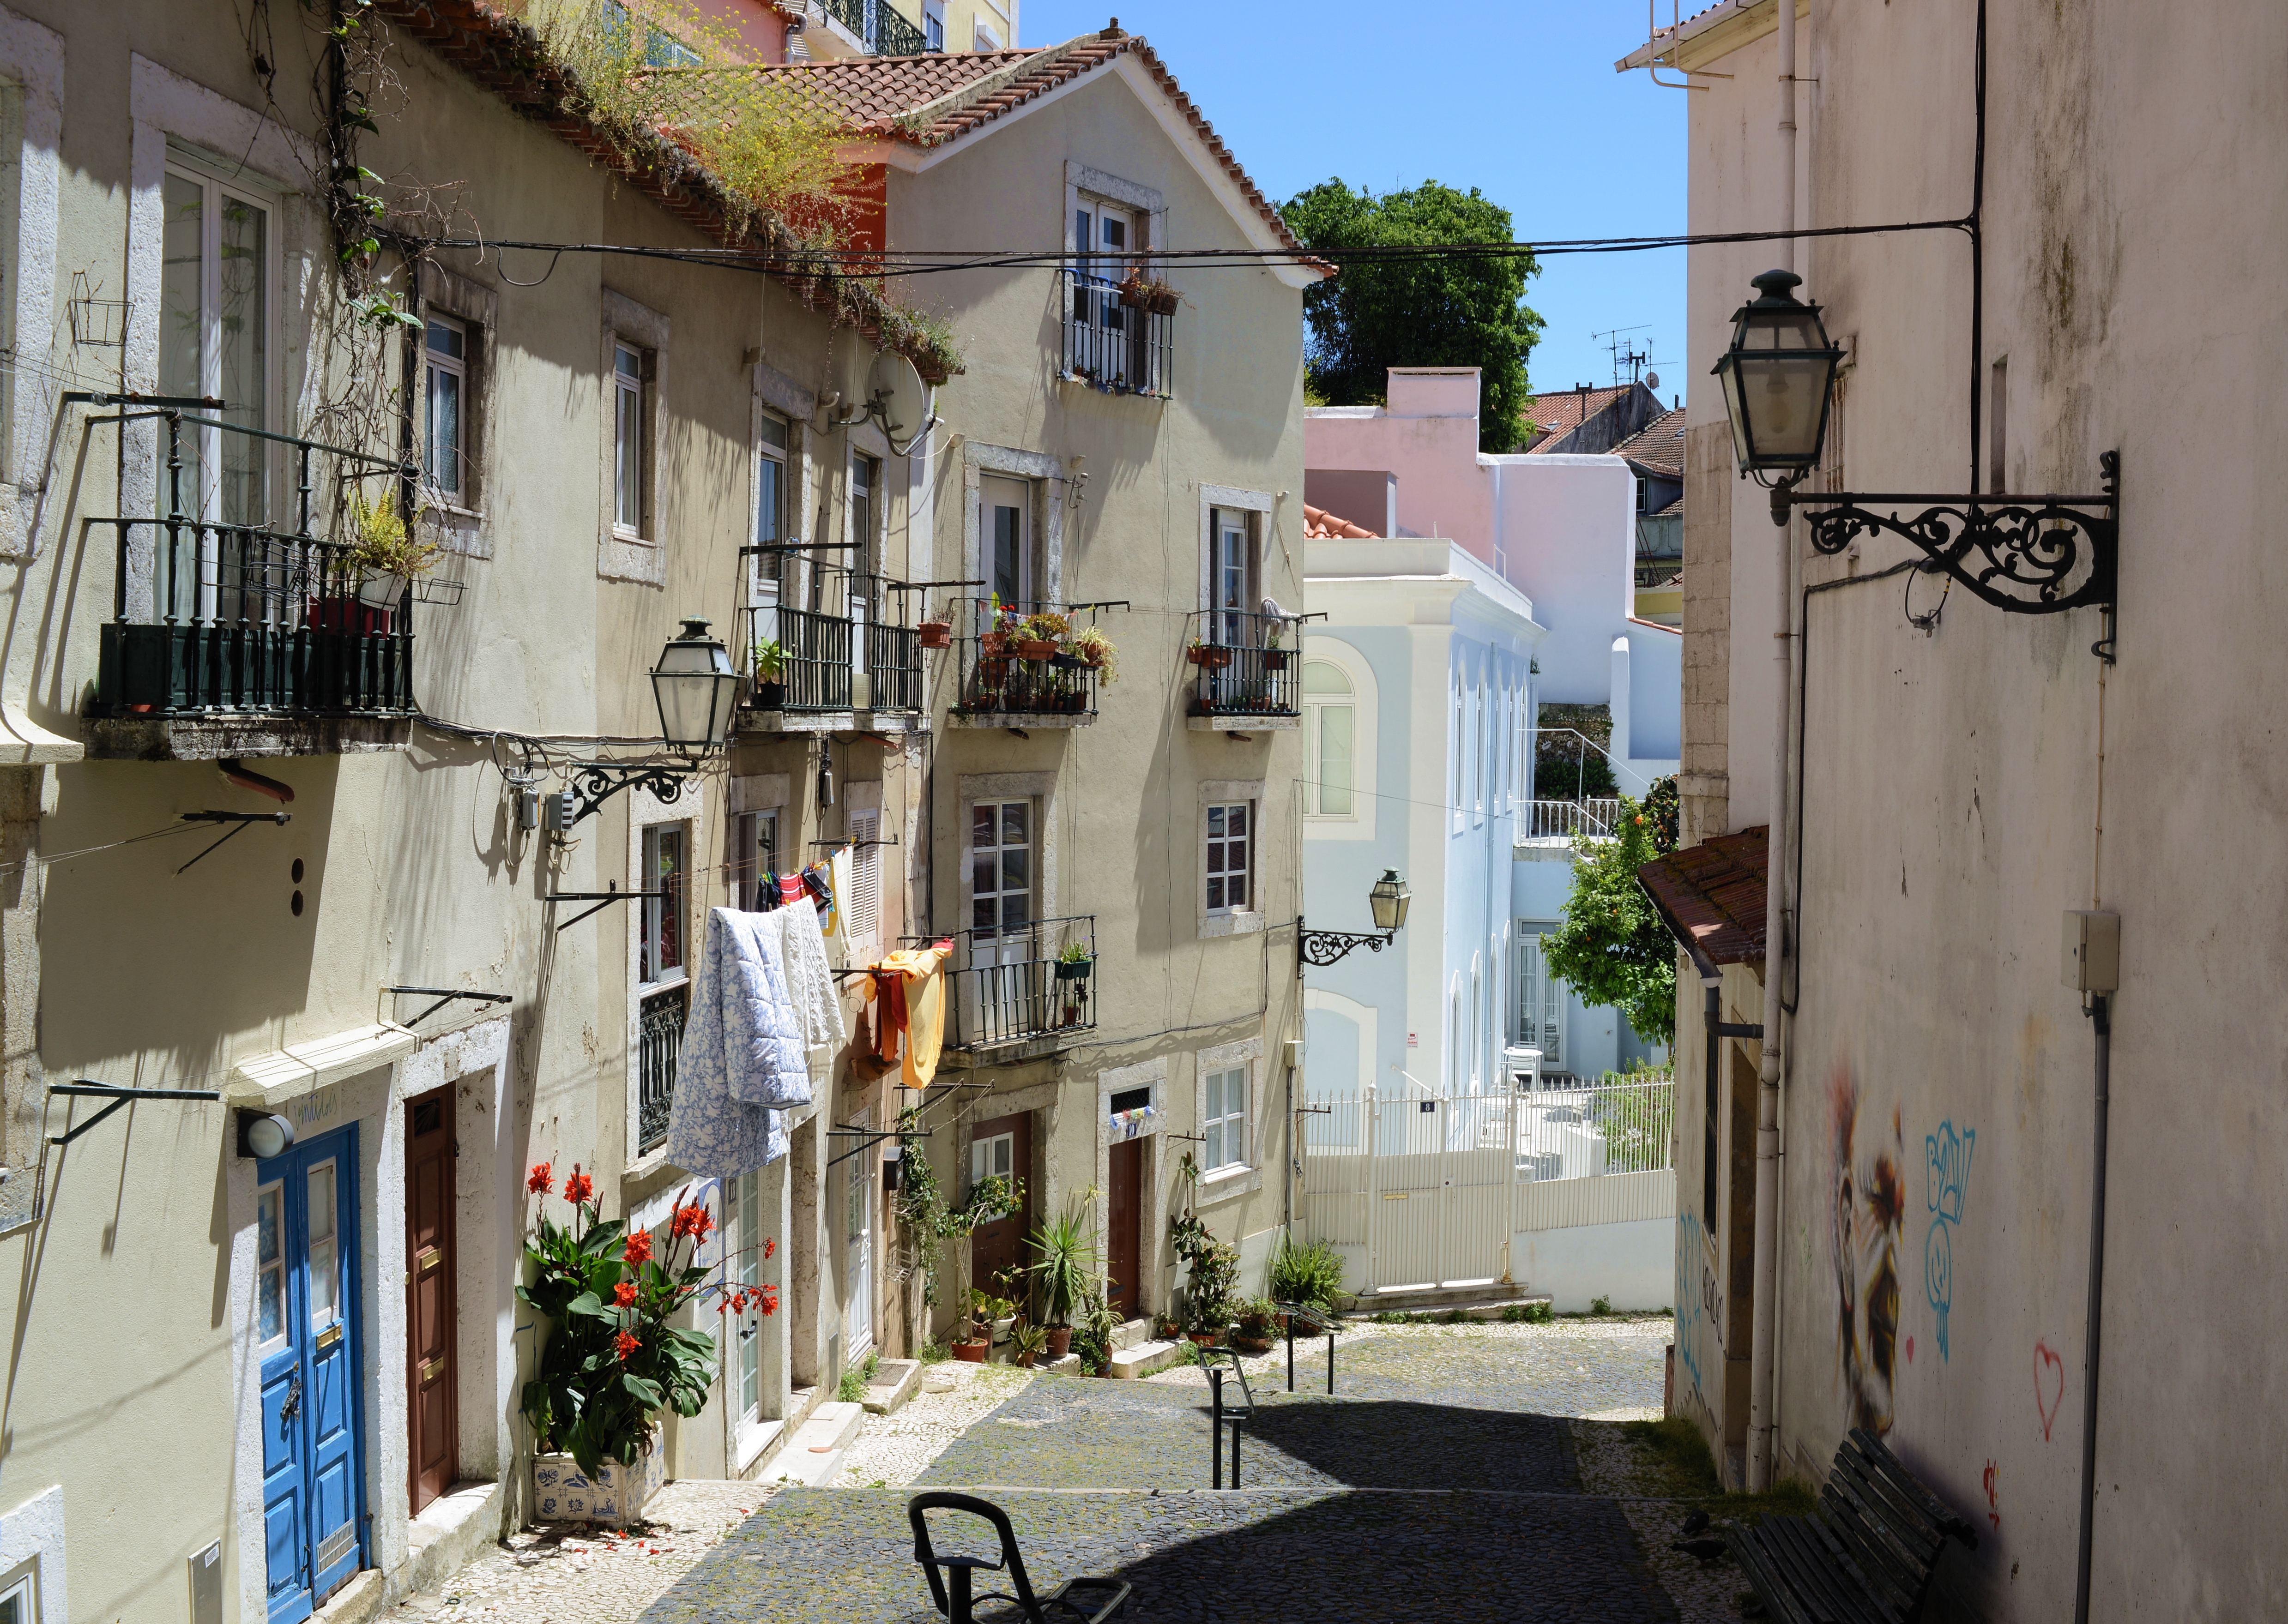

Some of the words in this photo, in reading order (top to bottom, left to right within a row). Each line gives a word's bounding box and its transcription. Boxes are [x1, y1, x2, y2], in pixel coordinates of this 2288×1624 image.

[1425, 1103, 1430, 1112] 8
[1129, 1124, 1135, 1136] 10
[730, 1182, 736, 1200] 18
